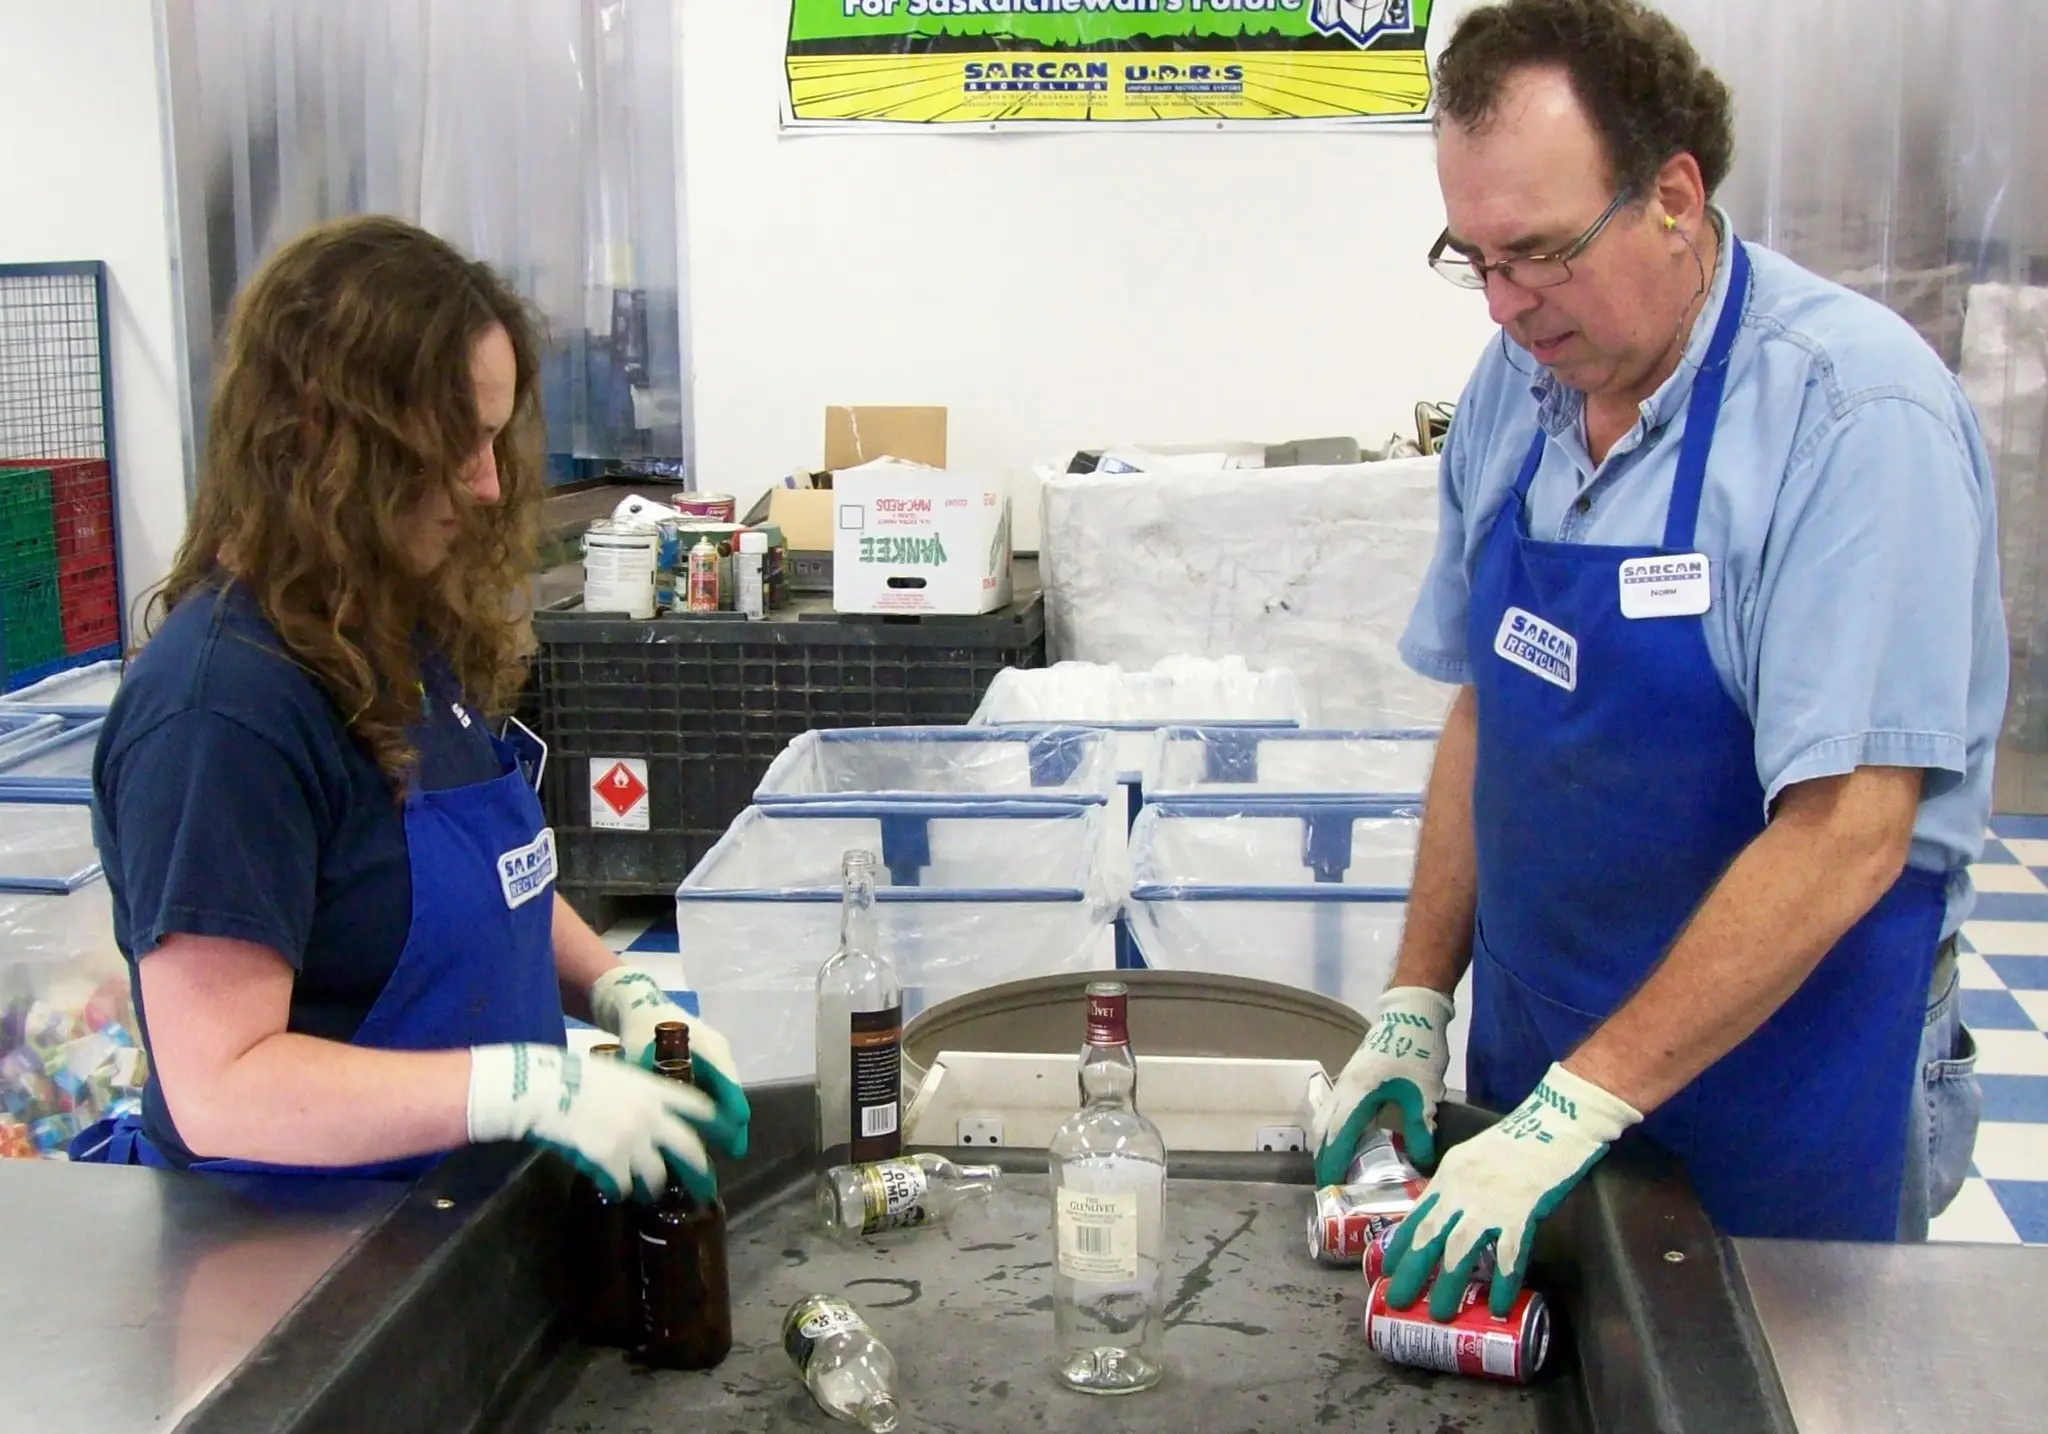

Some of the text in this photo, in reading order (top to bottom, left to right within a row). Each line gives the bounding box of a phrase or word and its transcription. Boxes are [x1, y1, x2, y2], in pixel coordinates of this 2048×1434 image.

[844, 0, 899, 16] For
[906, 0, 1183, 16] Saskacewans
[964, 62, 1108, 79] SARCAN
[969, 82, 1102, 90] RECYCLING
[859, 532, 947, 567] YANKEE
[1624, 562, 1702, 577] SARCAN
[1650, 588, 1678, 597] NORM
[1512, 615, 1572, 660] SARCAN
[1506, 636, 1570, 681] RECYCLING
[883, 1170, 899, 1204] TYME
[895, 1173, 909, 1197] OLD
[1070, 1201, 1116, 1213] GLENLIVET
